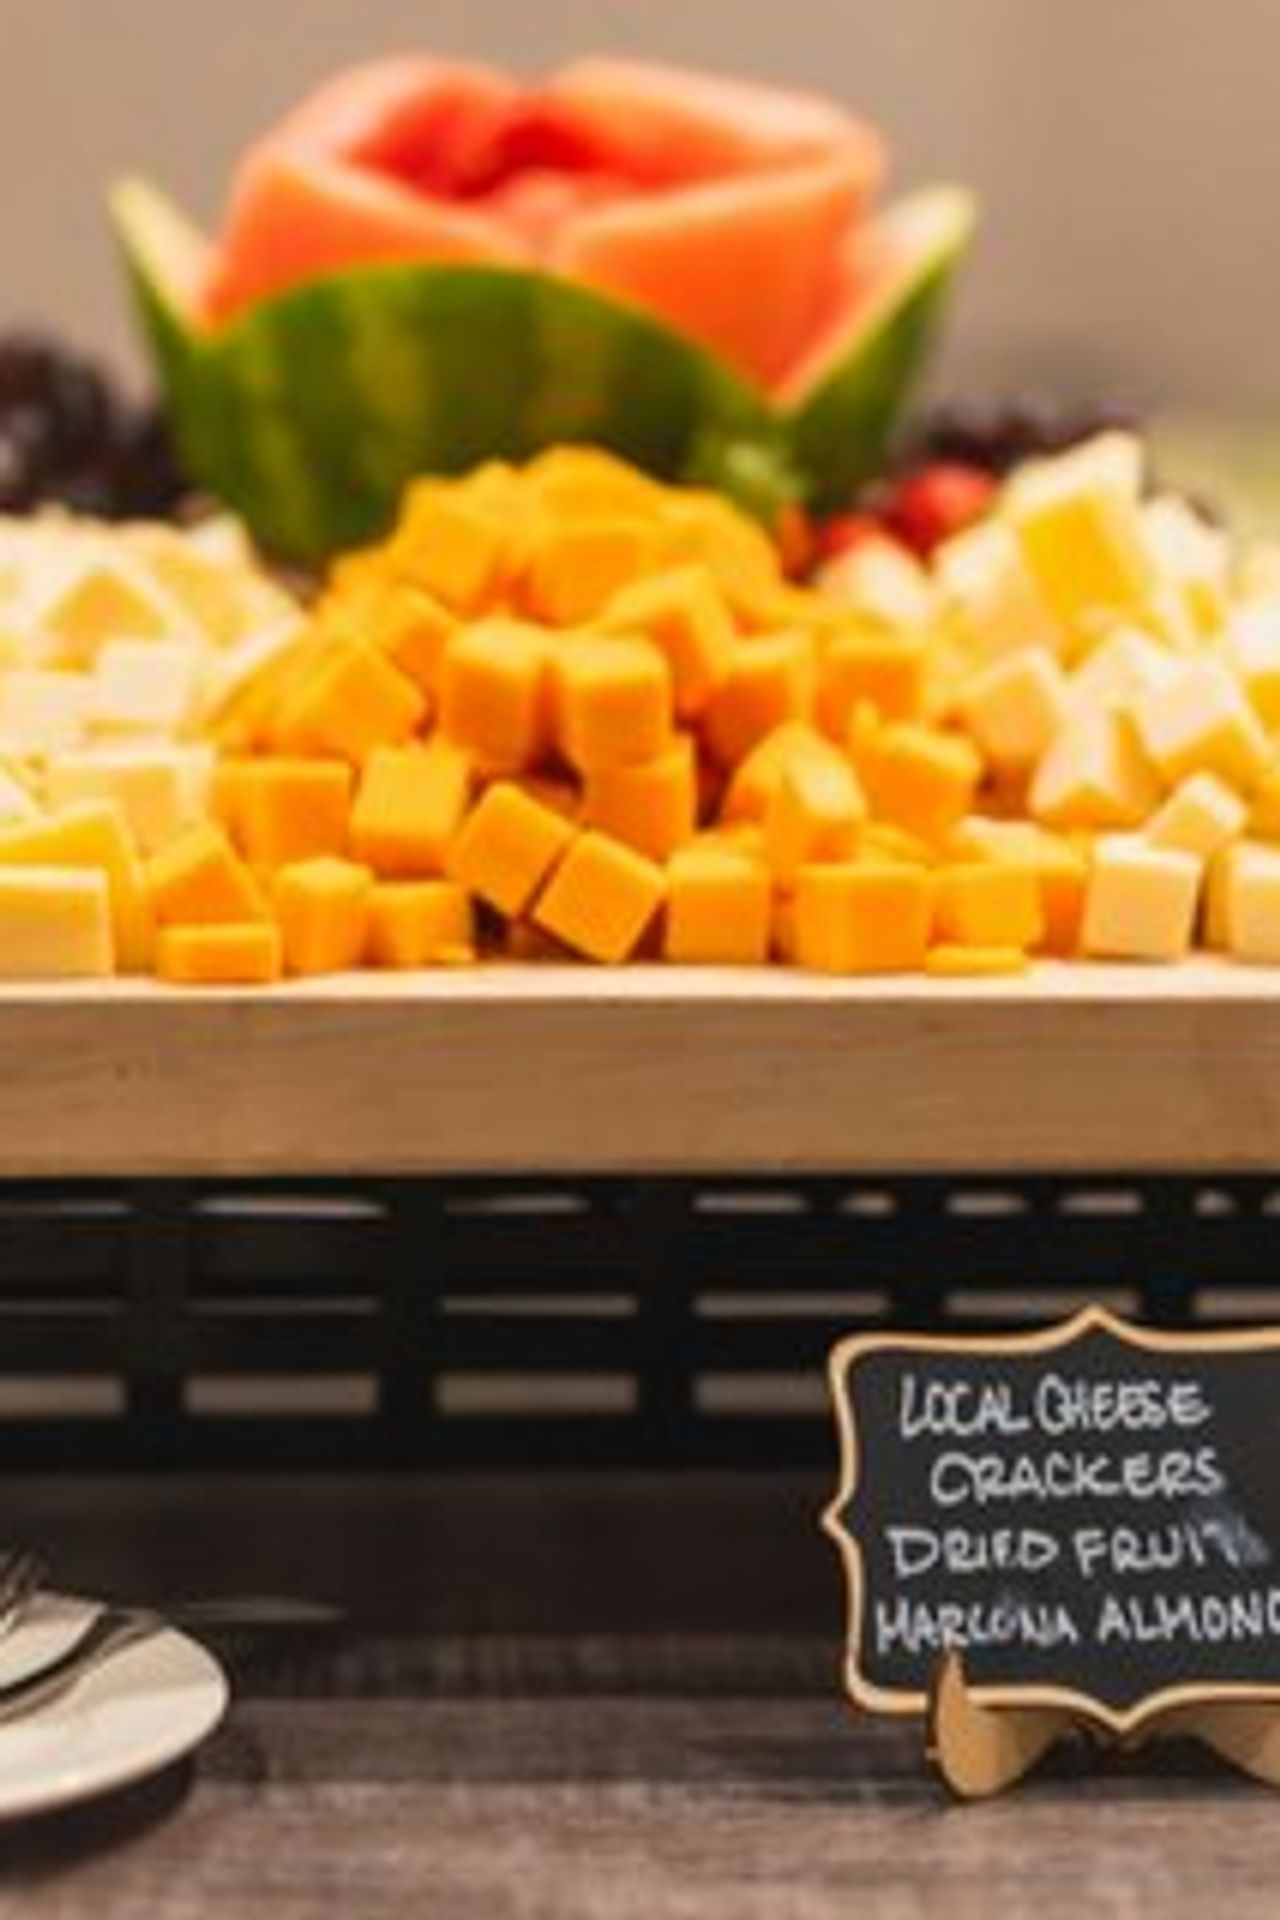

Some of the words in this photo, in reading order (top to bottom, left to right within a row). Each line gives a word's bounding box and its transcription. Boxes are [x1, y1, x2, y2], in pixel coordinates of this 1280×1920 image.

[901, 1374, 1030, 1438] LOCAL
[1035, 1374, 1213, 1433] CHEESE
[930, 1448, 1227, 1504] CRACKERS
[885, 1527, 1059, 1578] DRIED
